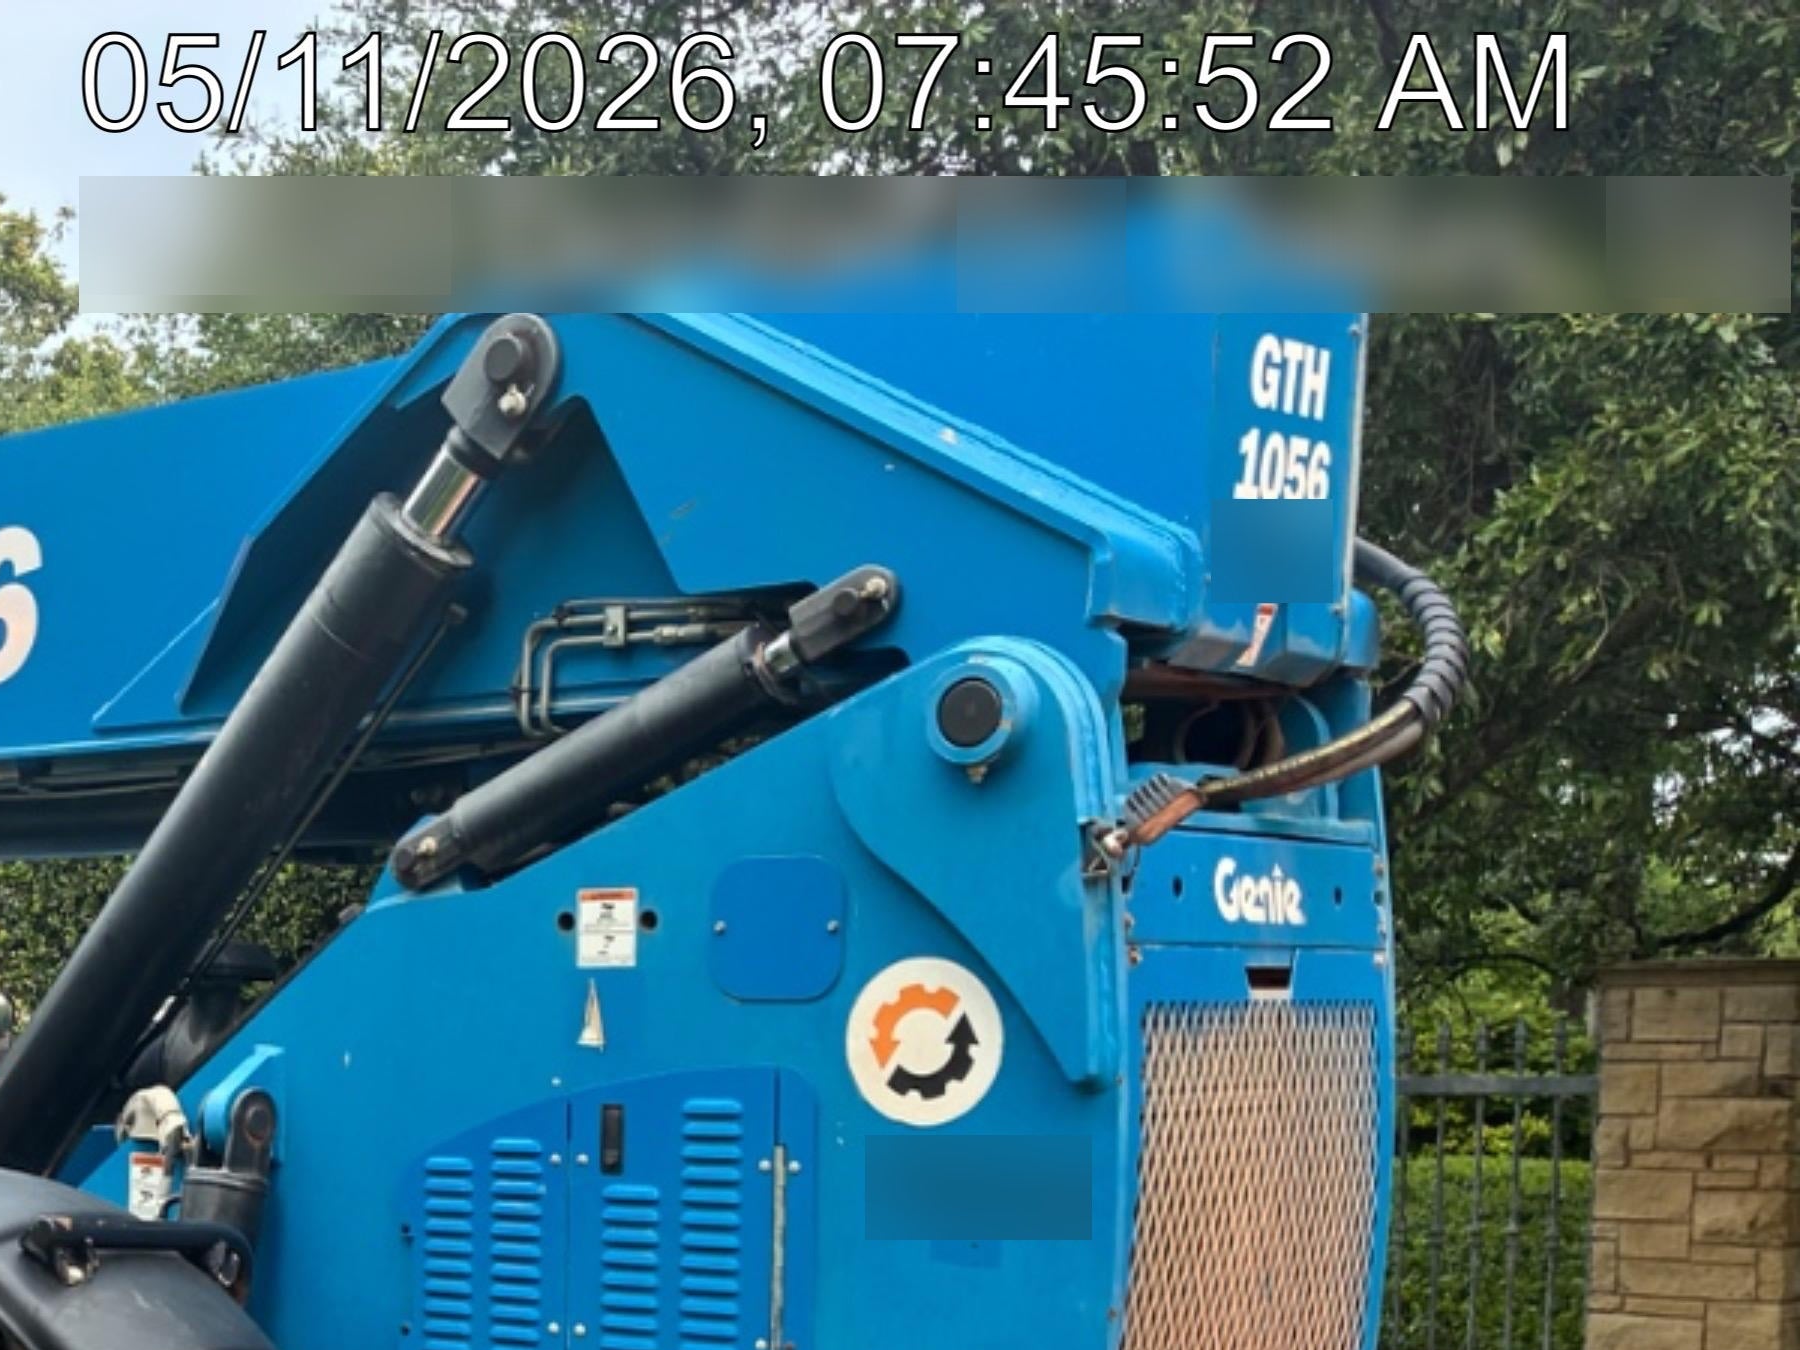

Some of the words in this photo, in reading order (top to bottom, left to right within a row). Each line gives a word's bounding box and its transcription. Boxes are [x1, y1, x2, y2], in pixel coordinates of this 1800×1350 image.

[1250, 333, 1331, 421] GTH
[1233, 427, 1332, 500] 1056
[1213, 856, 1307, 926] Genie
